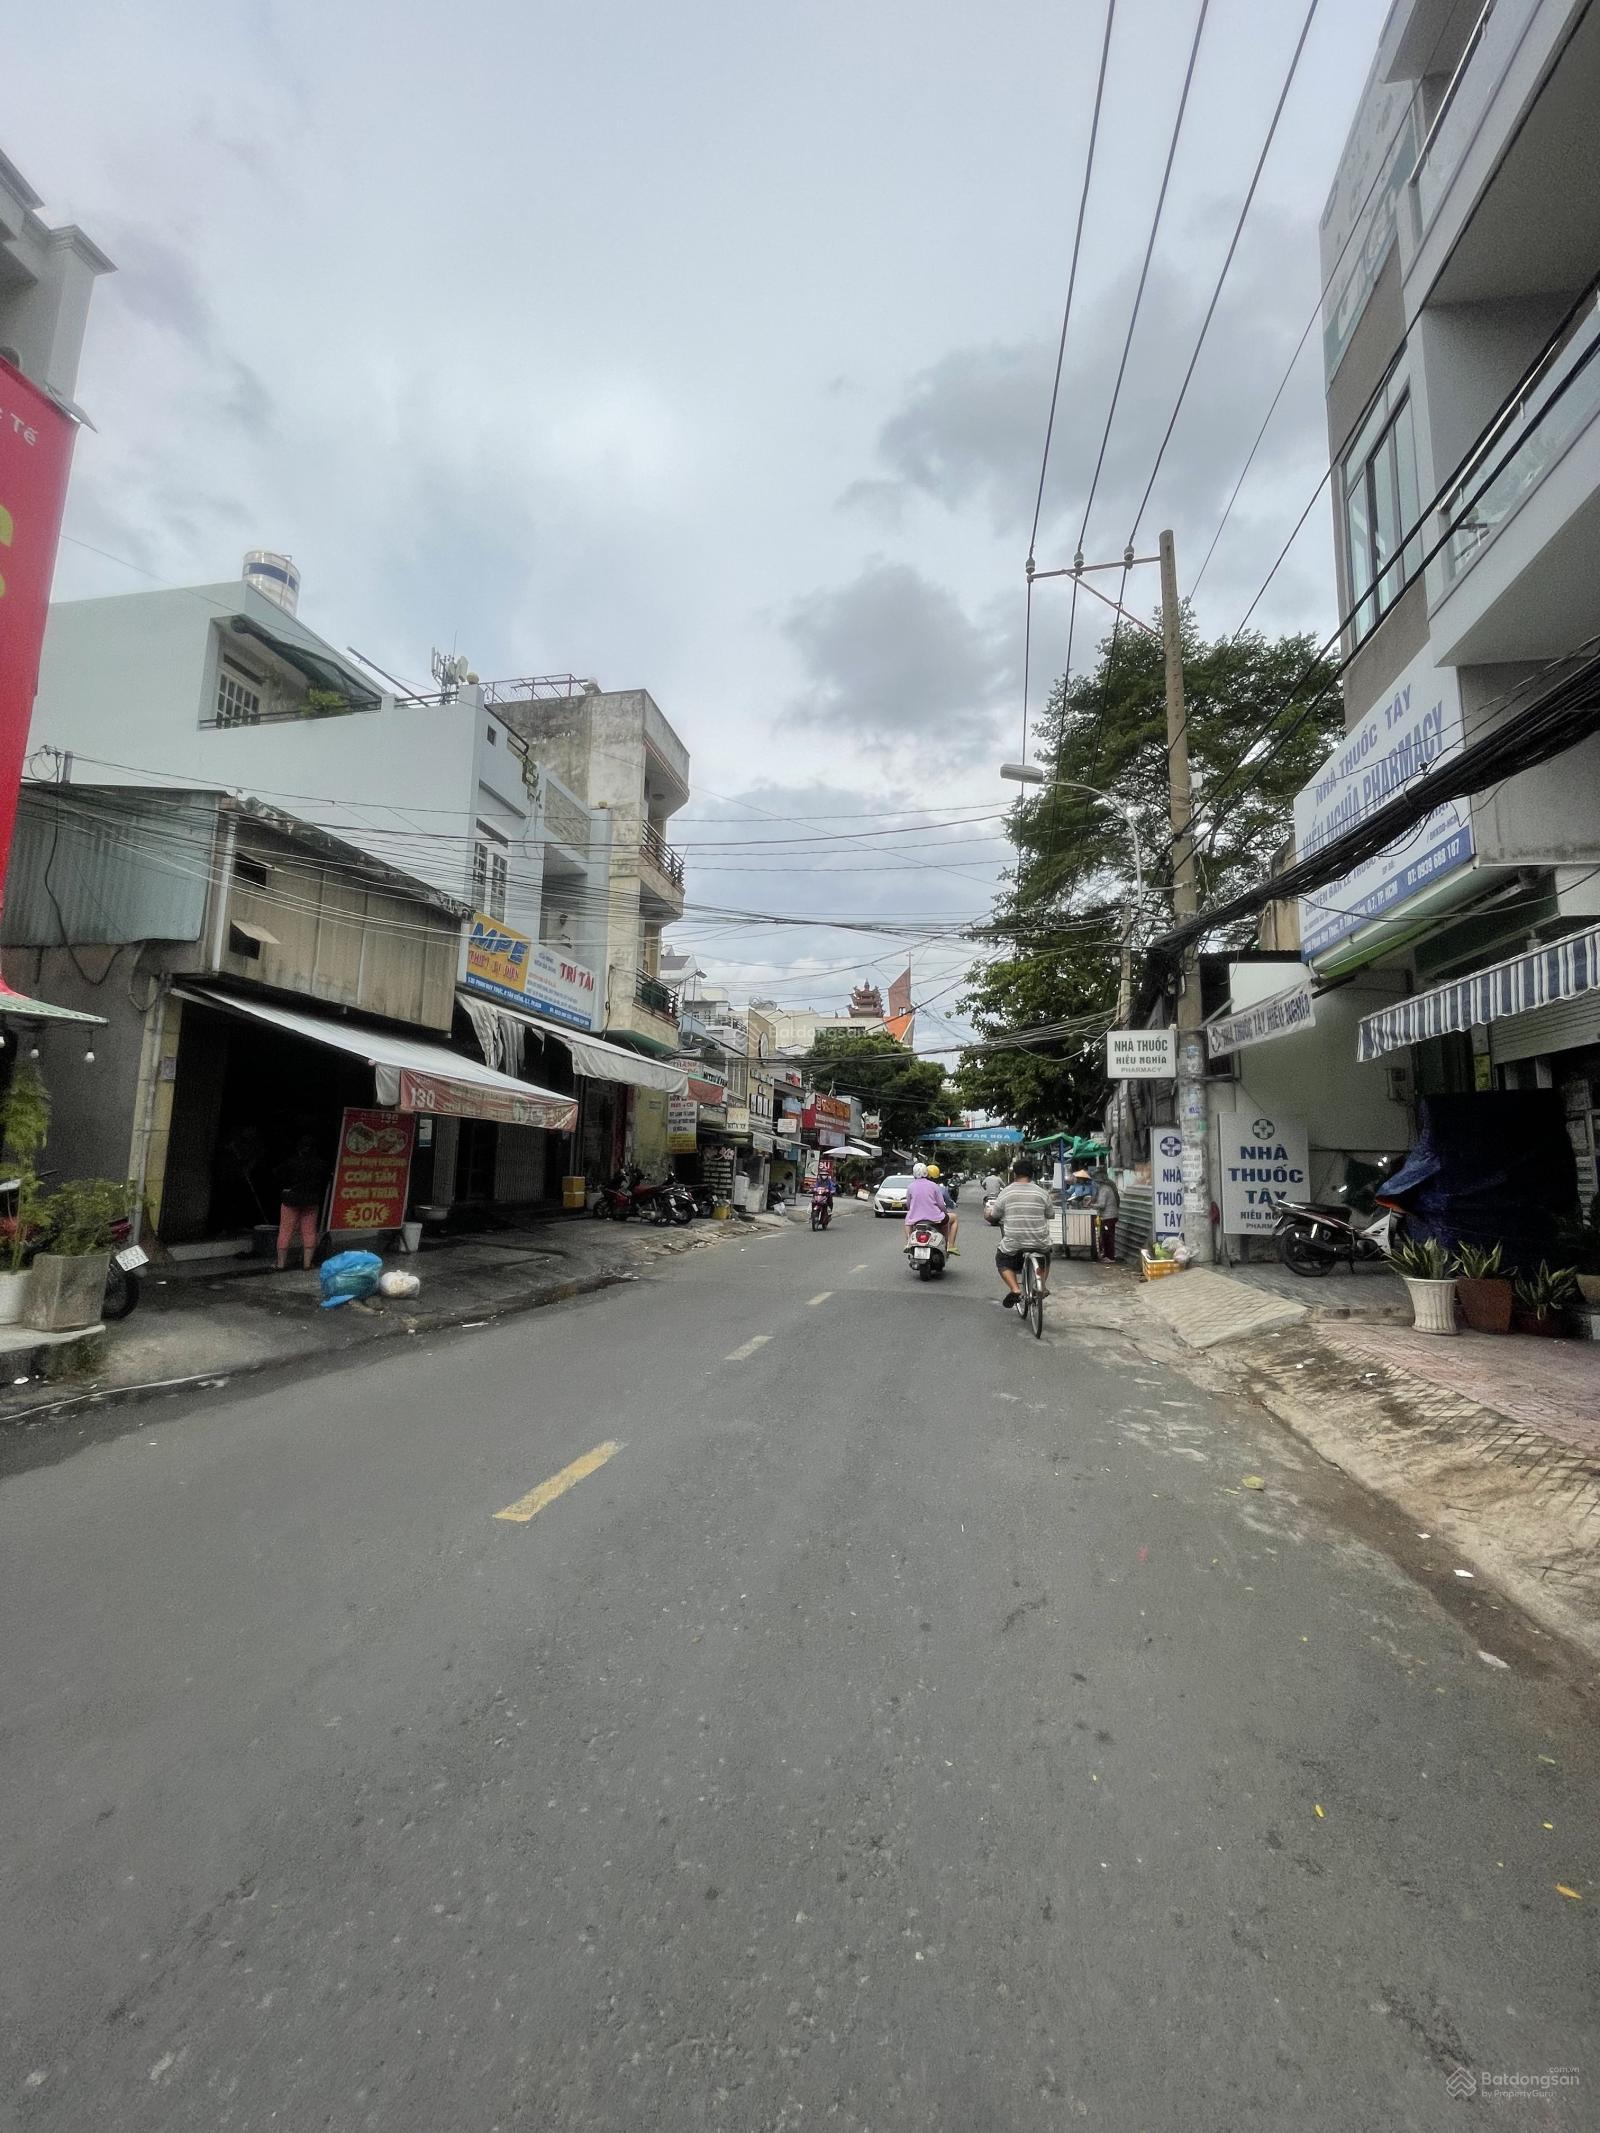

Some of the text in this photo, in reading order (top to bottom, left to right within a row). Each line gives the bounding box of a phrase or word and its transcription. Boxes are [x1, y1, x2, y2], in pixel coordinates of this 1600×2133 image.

[1315, 684, 1411, 807] NHÀ THUỐC TÂY
[1362, 700, 1443, 818] PHARMACY
[469, 923, 529, 965] MPE
[560, 962, 577, 983] TRÍ
[578, 970, 594, 992] TÀI
[1234, 1014, 1253, 1042] THUỐC
[1253, 1009, 1265, 1035] TÂY
[1285, 991, 1311, 1025] NGHĨA
[1114, 1035, 1168, 1052] NHÀ THUỐC
[1139, 1054, 1167, 1064] NGHĨA
[1240, 1144, 1288, 1160] NHÀ
[1162, 1167, 1183, 1183] NHÀ
[1228, 1164, 1303, 1183] THUỐC
[1156, 1188, 1183, 1206] THUỐ
[1245, 1188, 1288, 1205] TÂY
[354, 1206, 384, 1222] 30K
[1163, 1211, 1183, 1228] TÂY
